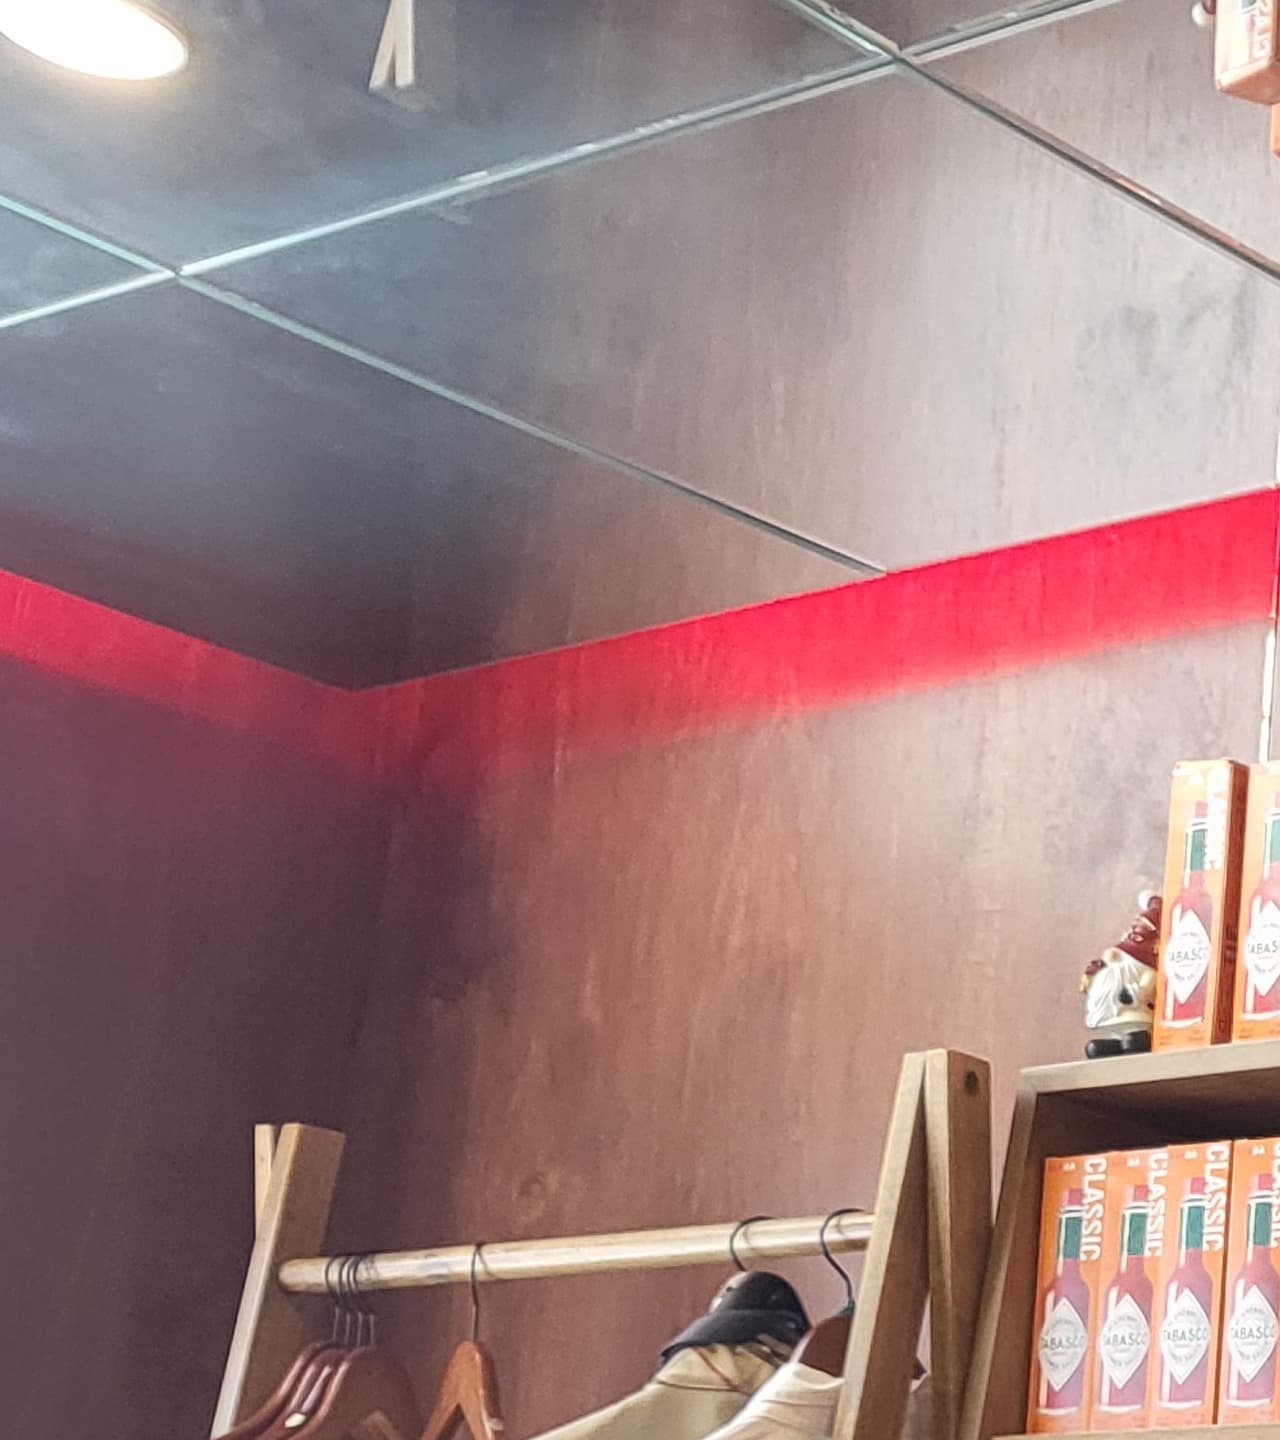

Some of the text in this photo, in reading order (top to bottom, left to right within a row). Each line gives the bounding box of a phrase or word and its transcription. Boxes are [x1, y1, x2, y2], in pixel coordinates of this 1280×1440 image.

[1168, 945, 1209, 963] ABASC
[1080, 1157, 1106, 1261] CLASSIC
[1145, 1152, 1168, 1257] CLASSIC
[1203, 1146, 1228, 1252] CLASSIC
